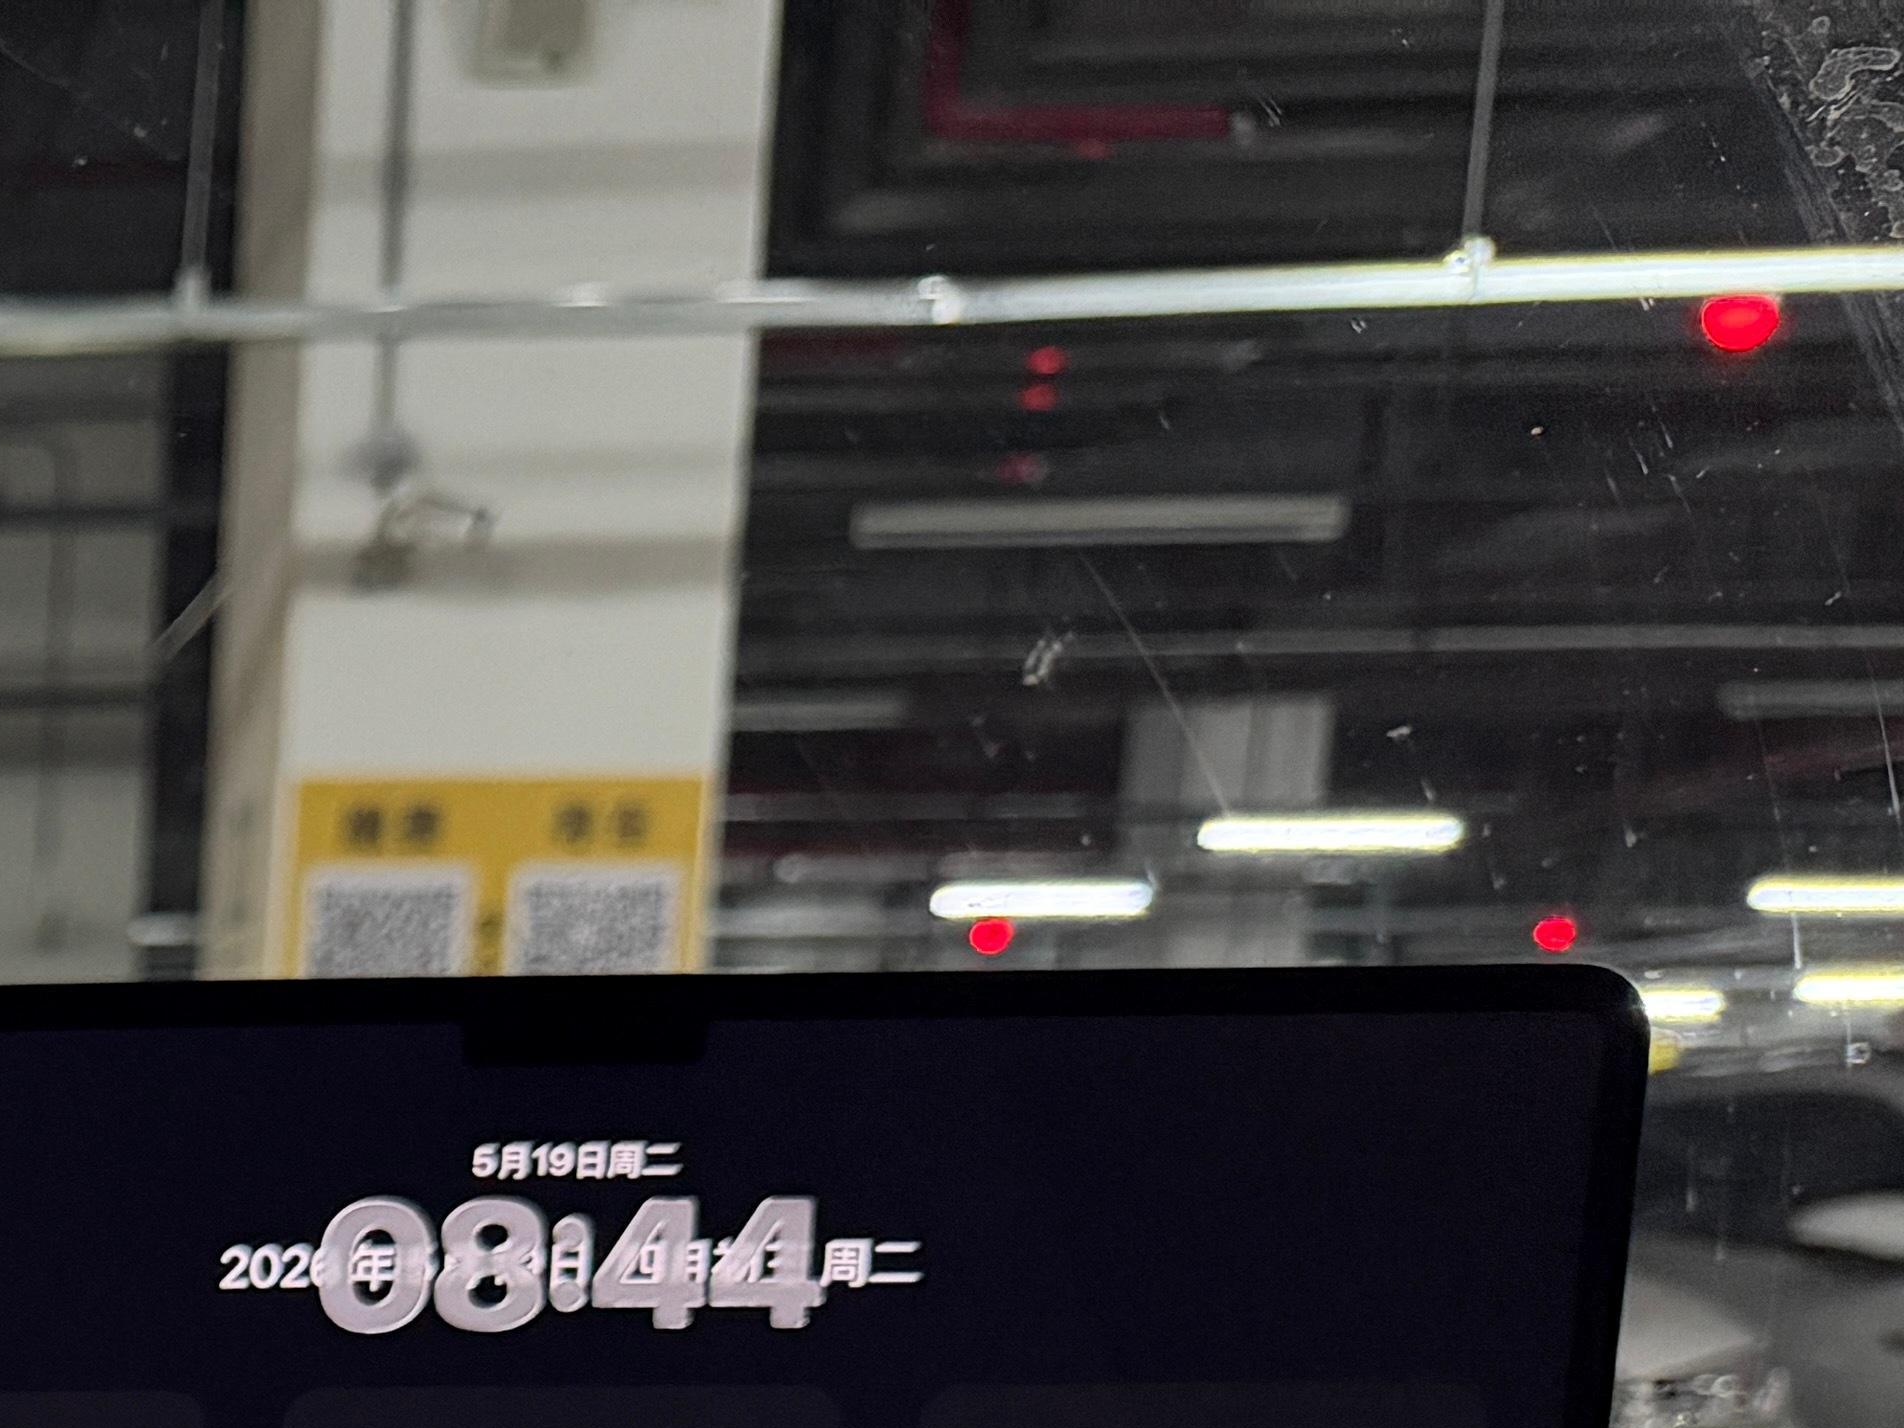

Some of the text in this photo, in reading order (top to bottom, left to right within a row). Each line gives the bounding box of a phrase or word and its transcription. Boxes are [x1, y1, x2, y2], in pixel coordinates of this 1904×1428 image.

[472, 1140, 683, 1180] 5月19日周二
[319, 1195, 826, 1334] 08:44
